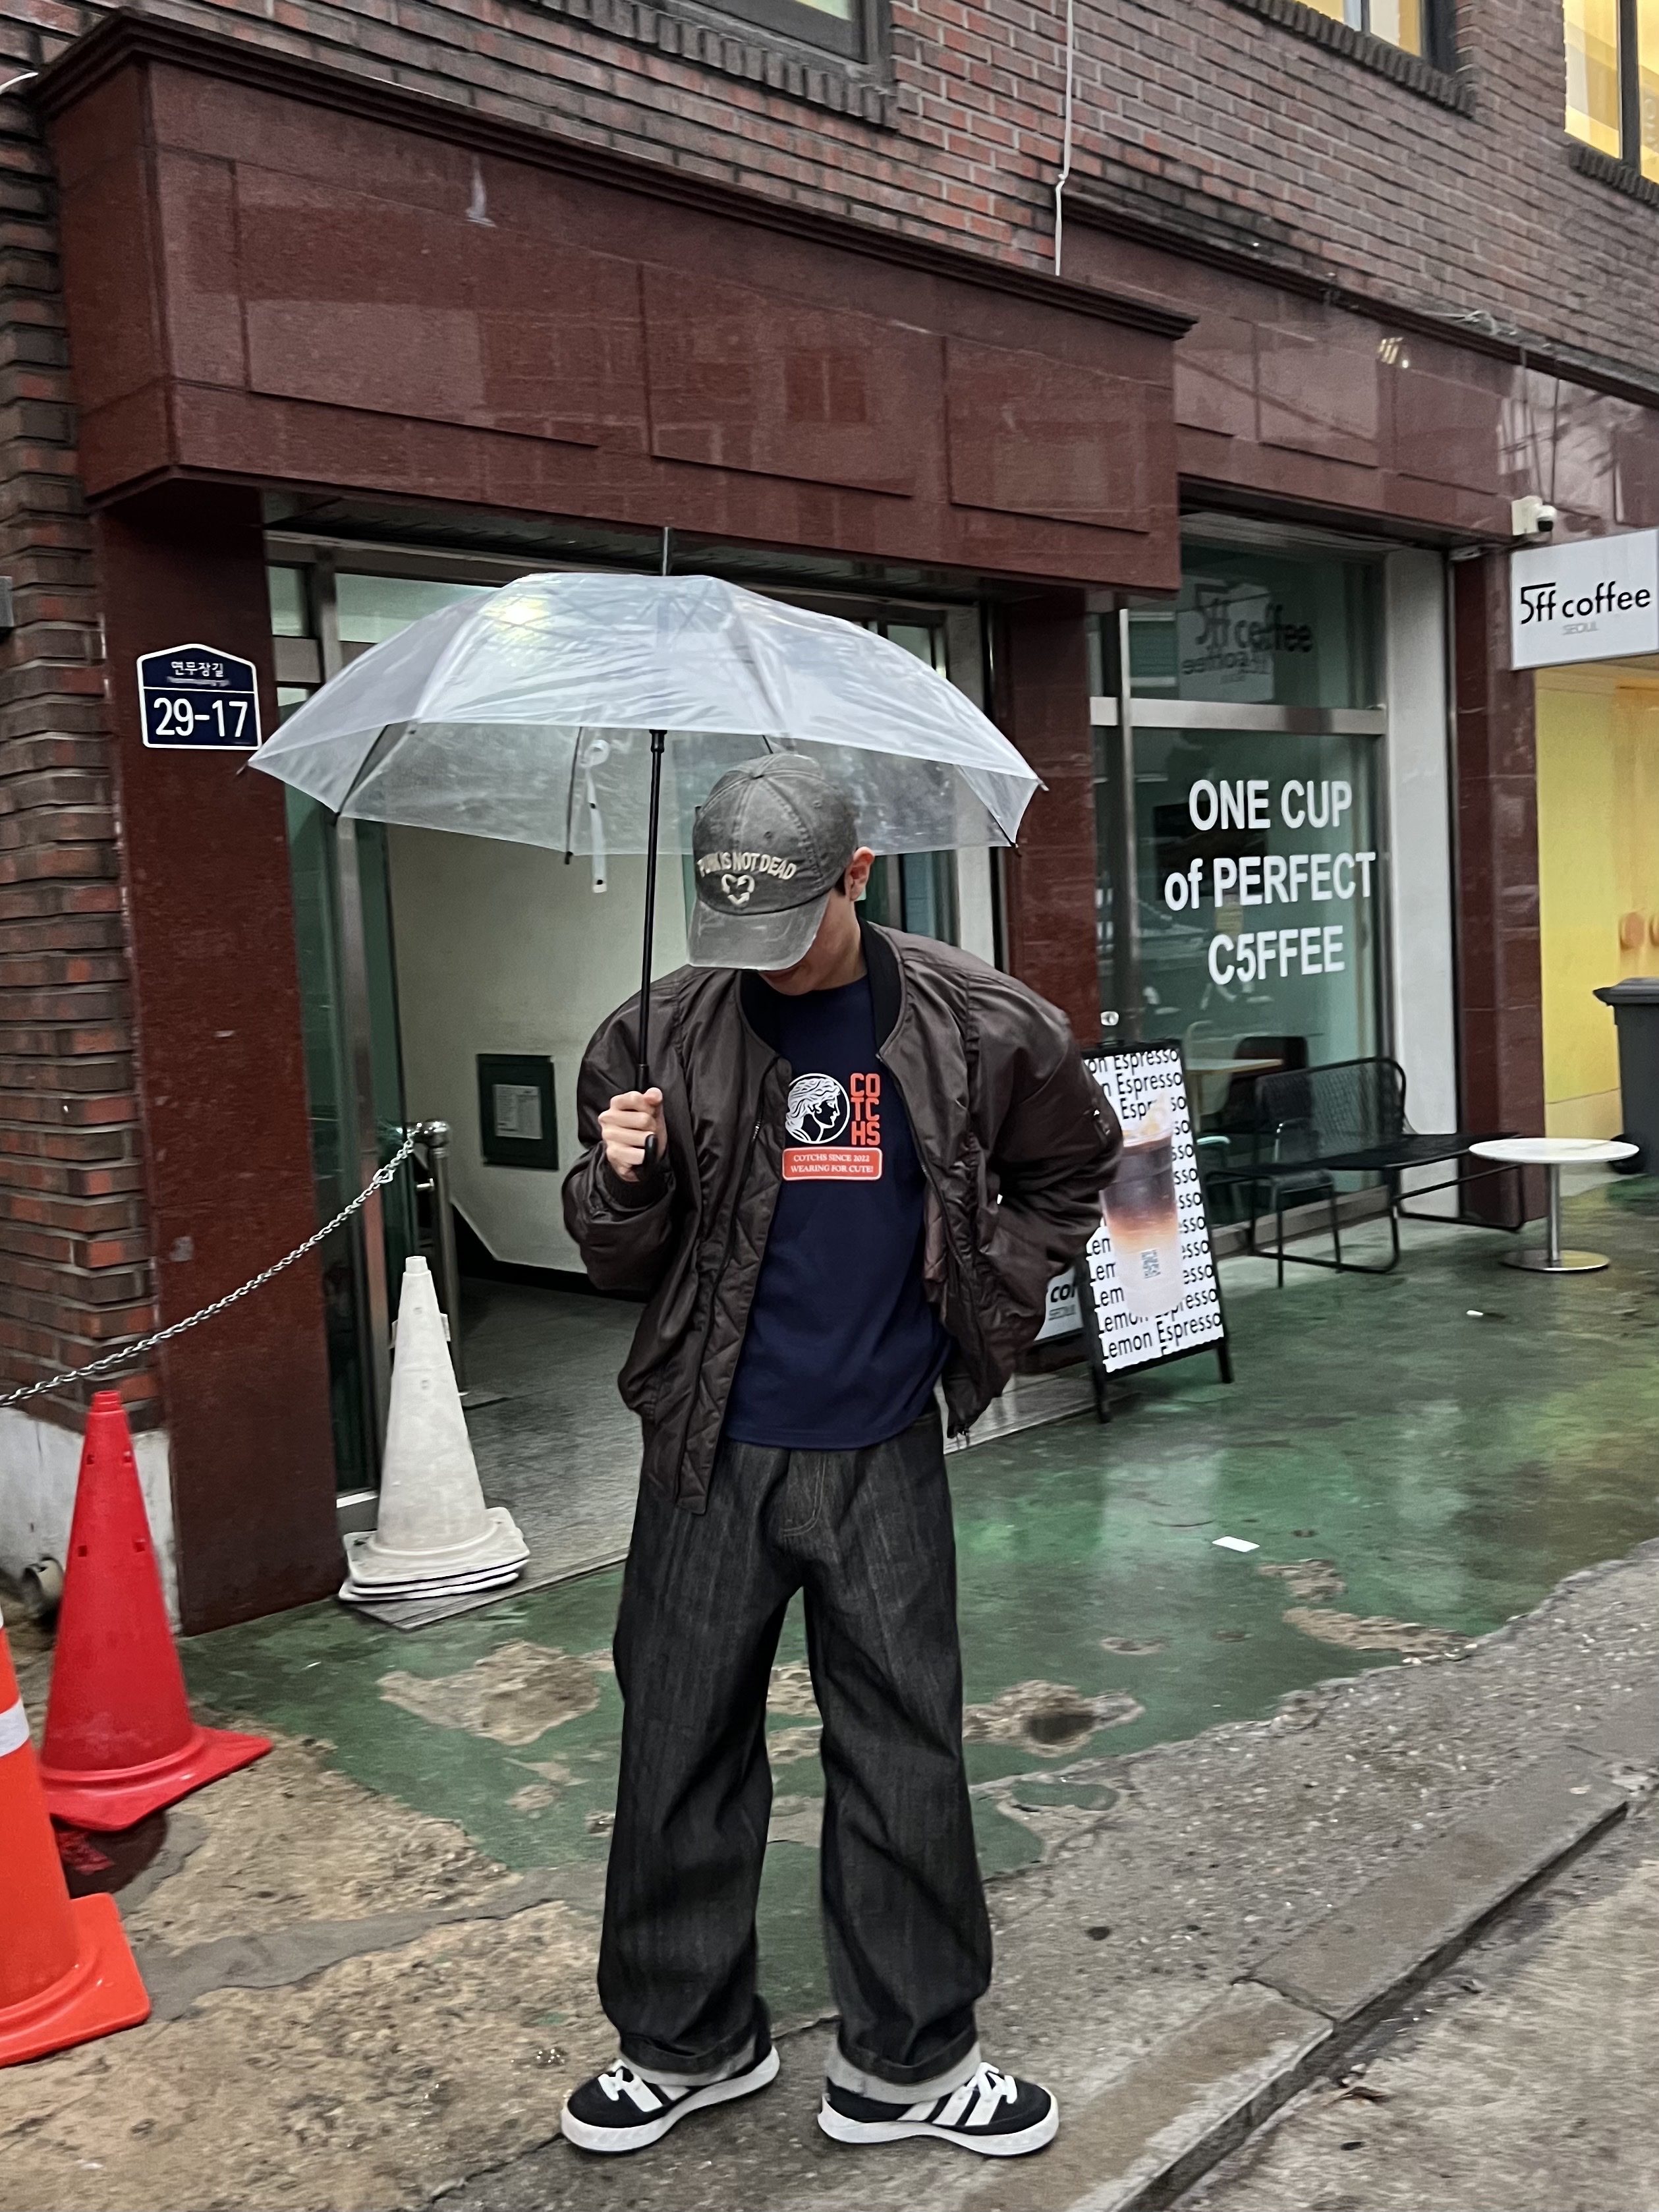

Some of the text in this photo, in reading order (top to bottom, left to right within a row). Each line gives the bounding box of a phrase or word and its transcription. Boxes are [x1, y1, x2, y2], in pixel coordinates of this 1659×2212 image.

[1521, 581, 1650, 625] 5ff coffee
[171, 661, 224, 677] 연무장길
[154, 697, 248, 737] 29-17
[1189, 780, 1352, 830] ONE CUP
[733, 852, 760, 872] NOT
[759, 854, 797, 880] DEAD
[1164, 852, 1376, 911] of PERFECT
[1208, 925, 1345, 985] C5FFEE
[1114, 1048, 1178, 1075] Espresso
[1116, 1072, 1183, 1100] Espresso
[791, 1164, 830, 1173] WEARING
[793, 1154, 828, 1162] COTCHS
[828, 1154, 852, 1162] SINCE
[1156, 1313, 1221, 1347] Espresso
